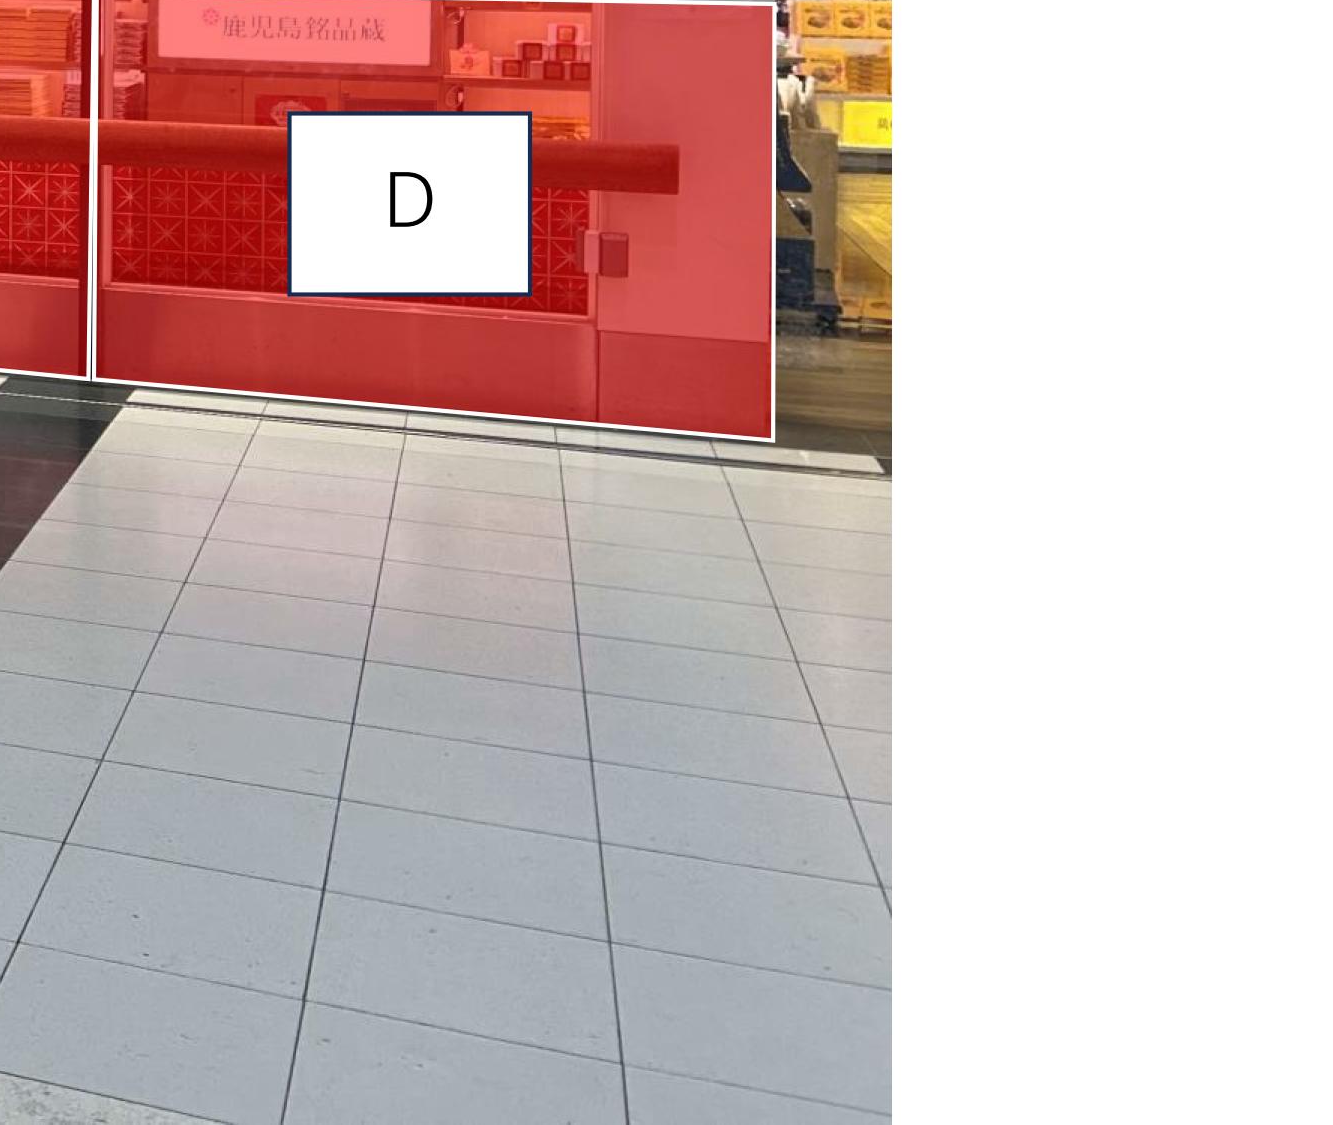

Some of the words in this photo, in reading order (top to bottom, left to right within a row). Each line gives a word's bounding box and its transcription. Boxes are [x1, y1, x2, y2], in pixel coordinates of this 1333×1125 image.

[222, 14, 386, 43] 鹿児島銘品蔵
